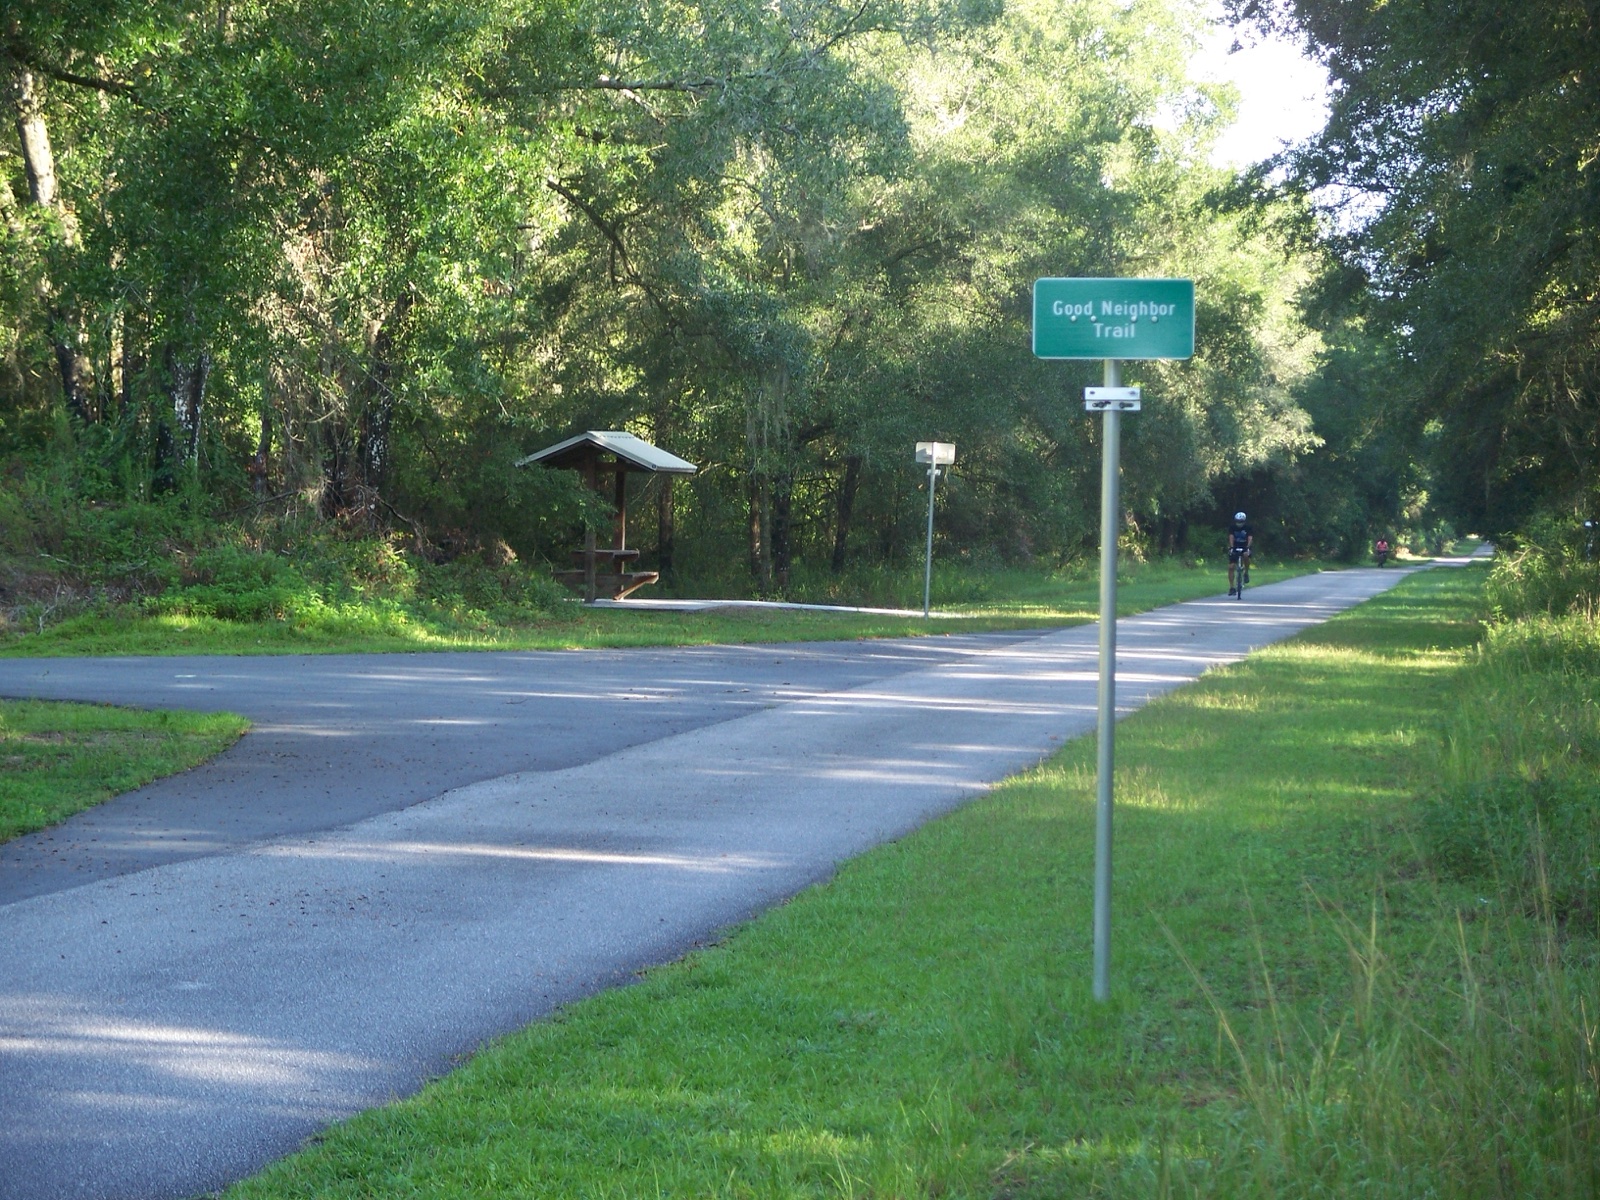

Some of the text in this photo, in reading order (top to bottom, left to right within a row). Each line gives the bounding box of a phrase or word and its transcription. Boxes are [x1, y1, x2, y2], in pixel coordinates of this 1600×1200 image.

[1053, 300, 1176, 321] Good Neighbor
[1093, 322, 1136, 338] Trail
